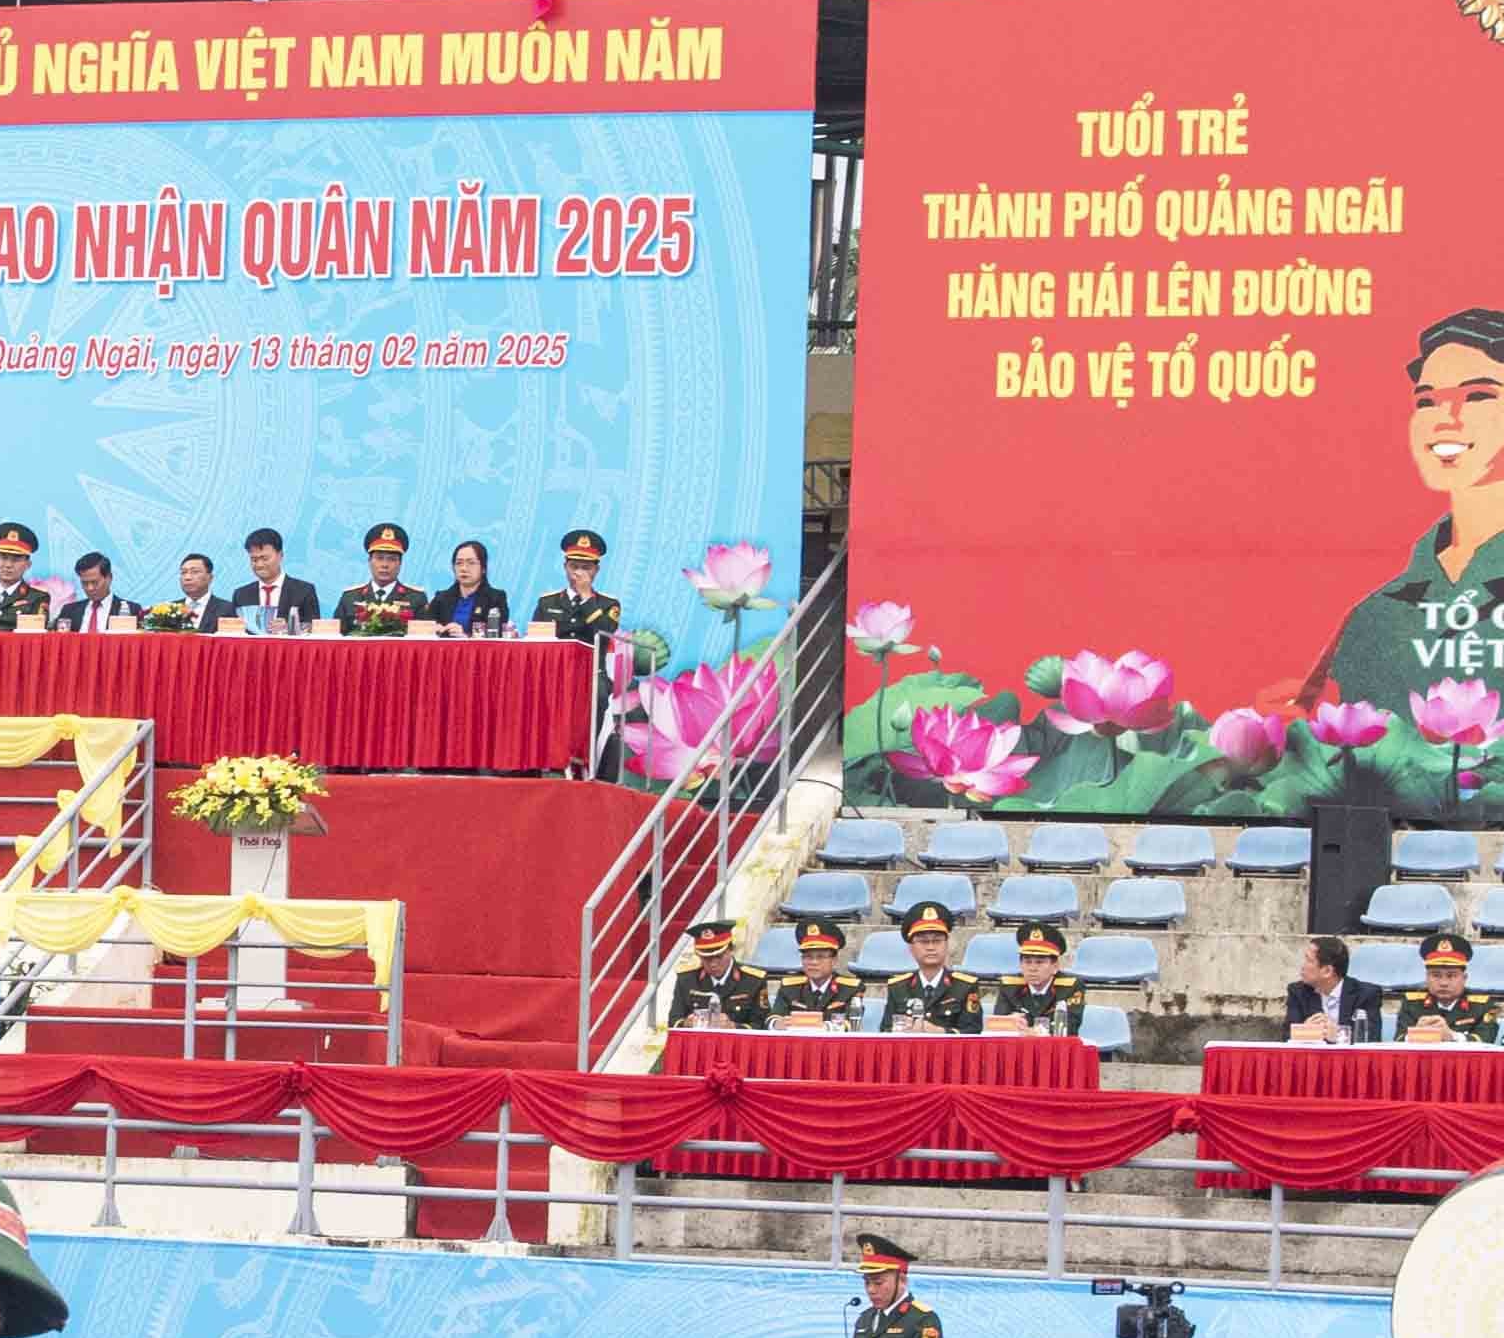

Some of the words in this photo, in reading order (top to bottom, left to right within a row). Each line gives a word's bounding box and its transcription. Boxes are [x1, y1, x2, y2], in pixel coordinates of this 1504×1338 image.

[32, 30, 179, 95] NGHĨA
[194, 27, 296, 101] VIỆT
[309, 34, 424, 89] NAM
[439, 21, 589, 86] MUÔN
[604, 16, 724, 82] NĂM
[1076, 91, 1165, 157] TUỔI
[1176, 92, 1249, 155] TRẺ
[73, 186, 226, 295] NHẬN
[241, 185, 394, 285] QUÂN
[408, 182, 540, 278] NĂM
[554, 196, 695, 275] 2025
[923, 183, 1052, 239] THÀNH
[1063, 174, 1145, 238] PHỐ
[1155, 173, 1293, 242] QUẢNG
[1305, 176, 1405, 234] NGÃI
[947, 262, 1056, 318] HĂNG
[1067, 262, 1135, 318] HÁI
[1145, 261, 1222, 317] LÊN
[1232, 257, 1372, 316] ĐƯỜNG
[86, 337, 158, 375] Ngãi,
[166, 338, 240, 375] ngày
[248, 337, 283, 370] 13
[289, 336, 371, 374] tháng
[380, 336, 417, 367] 02
[424, 336, 487, 368] năm
[495, 335, 568, 366] 2025
[995, 337, 1075, 398] BẢO
[1087, 342, 1136, 409] VỆ
[1147, 333, 1199, 397] TỔ
[1207, 333, 1317, 403] QUỐC
[1418, 590, 1479, 631] TỔ
